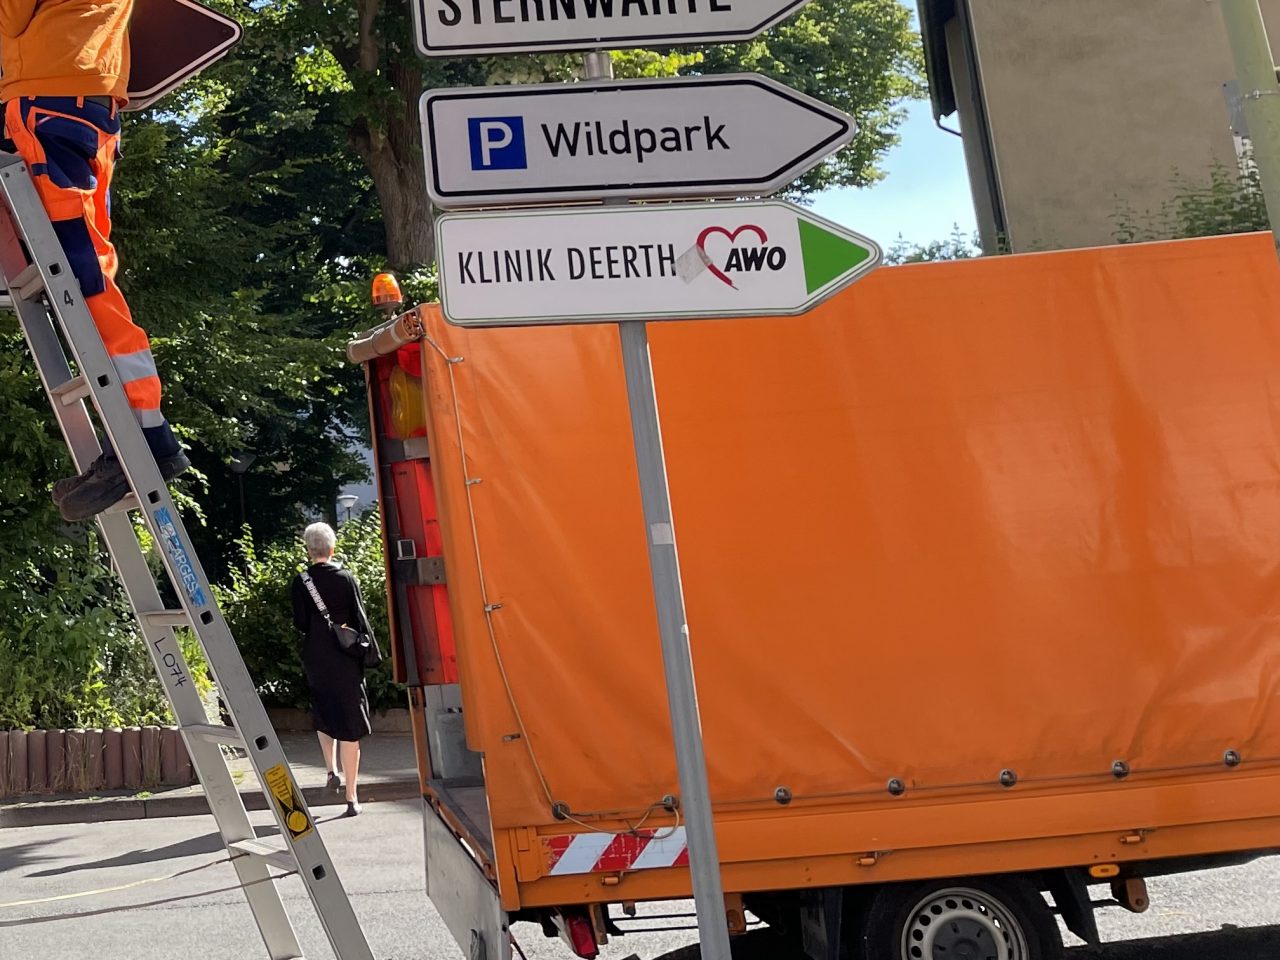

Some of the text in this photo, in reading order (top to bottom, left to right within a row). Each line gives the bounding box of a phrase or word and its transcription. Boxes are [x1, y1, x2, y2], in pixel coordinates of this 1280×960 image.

[479, 116, 731, 166] P Wildpark
[459, 243, 677, 285] KLINIK DEERTH
[724, 246, 787, 273] AWO
[63, 289, 74, 307] 4
